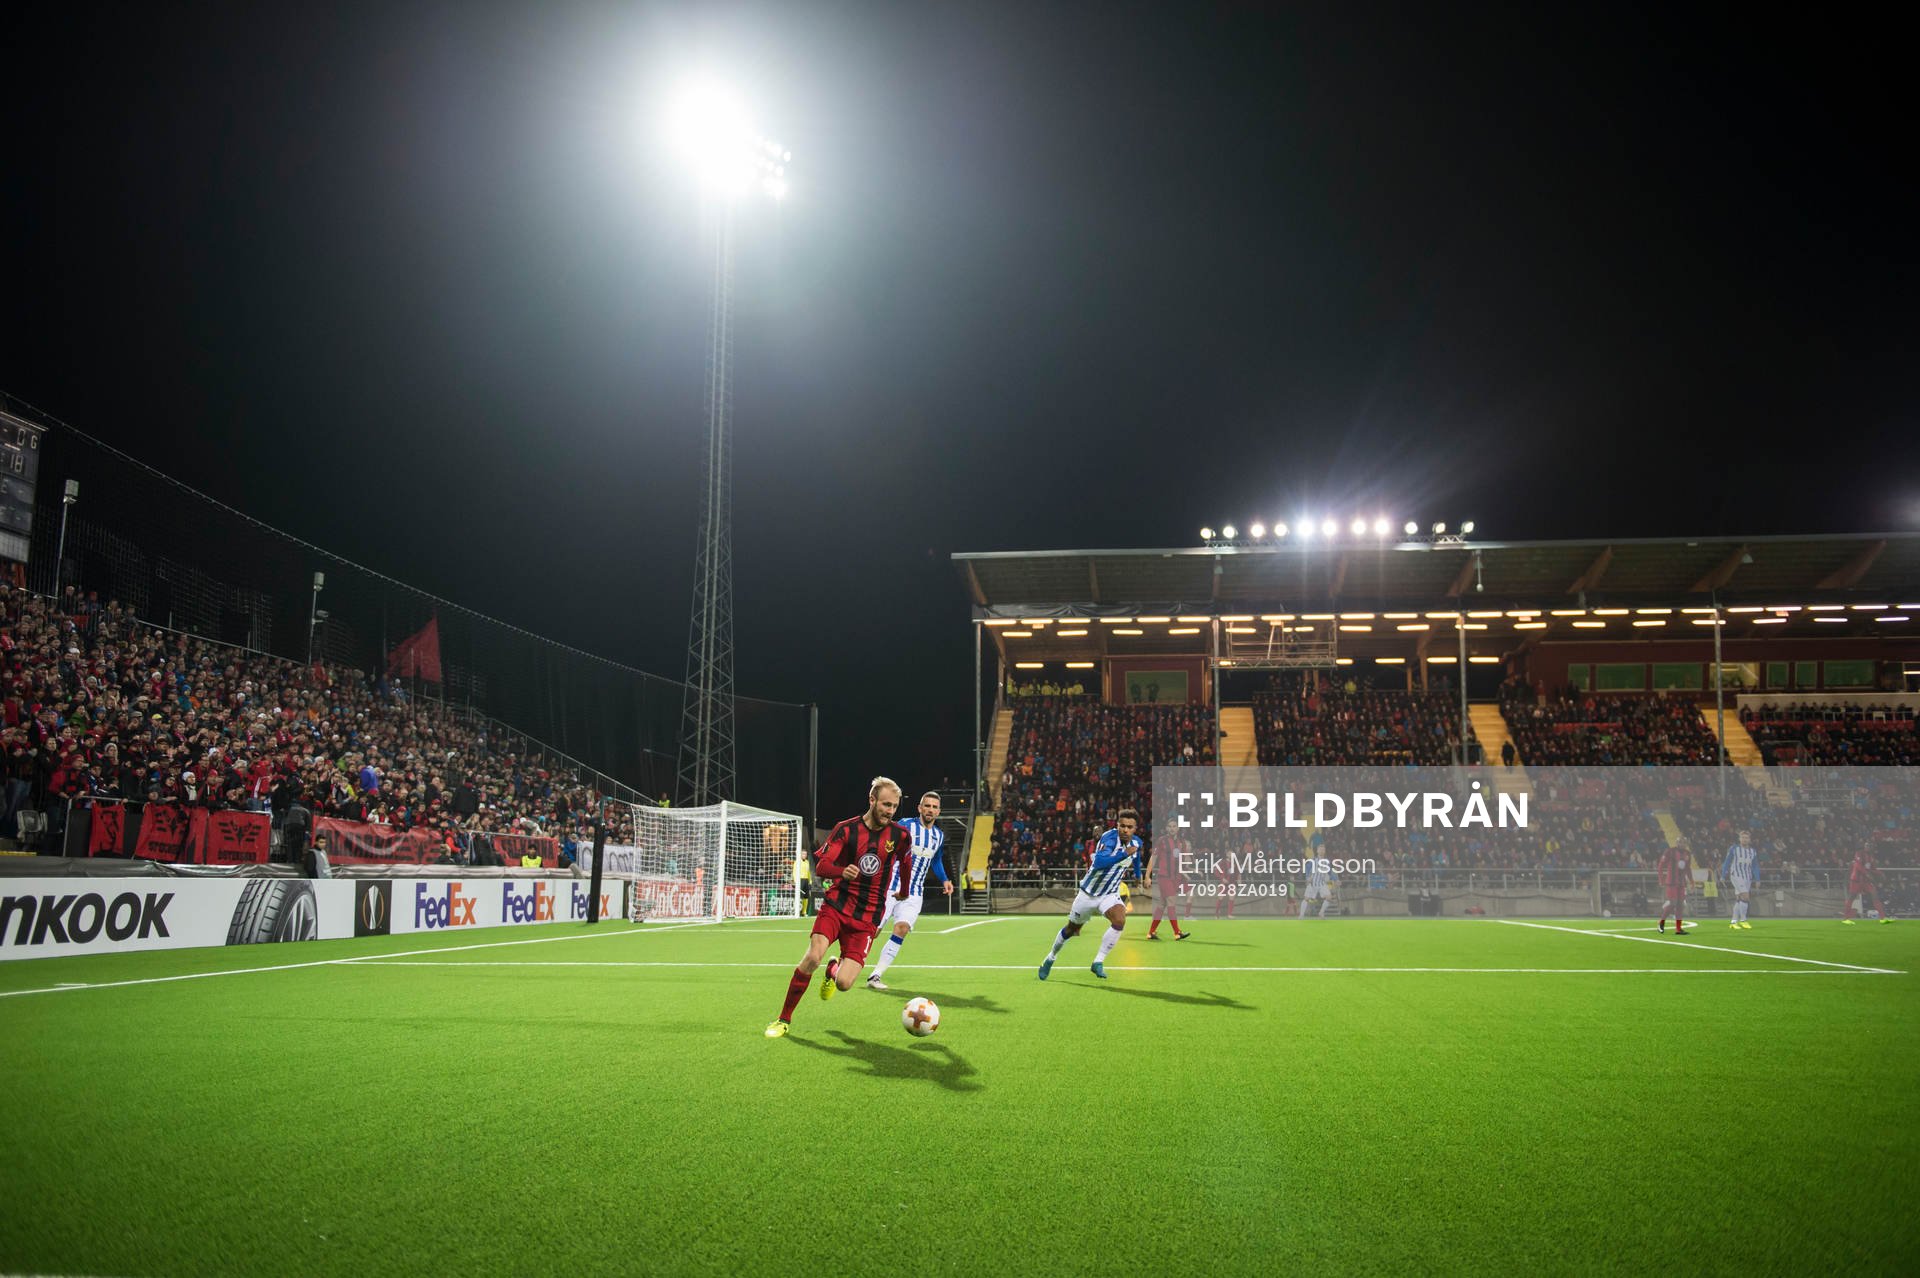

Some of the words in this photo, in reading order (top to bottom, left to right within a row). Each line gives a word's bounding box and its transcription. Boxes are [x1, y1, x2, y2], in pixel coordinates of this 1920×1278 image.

[415, 882, 477, 929] FedEx
[502, 881, 555, 923] FedEx
[571, 882, 610, 919] Fex
[652, 884, 704, 916] UniCredit
